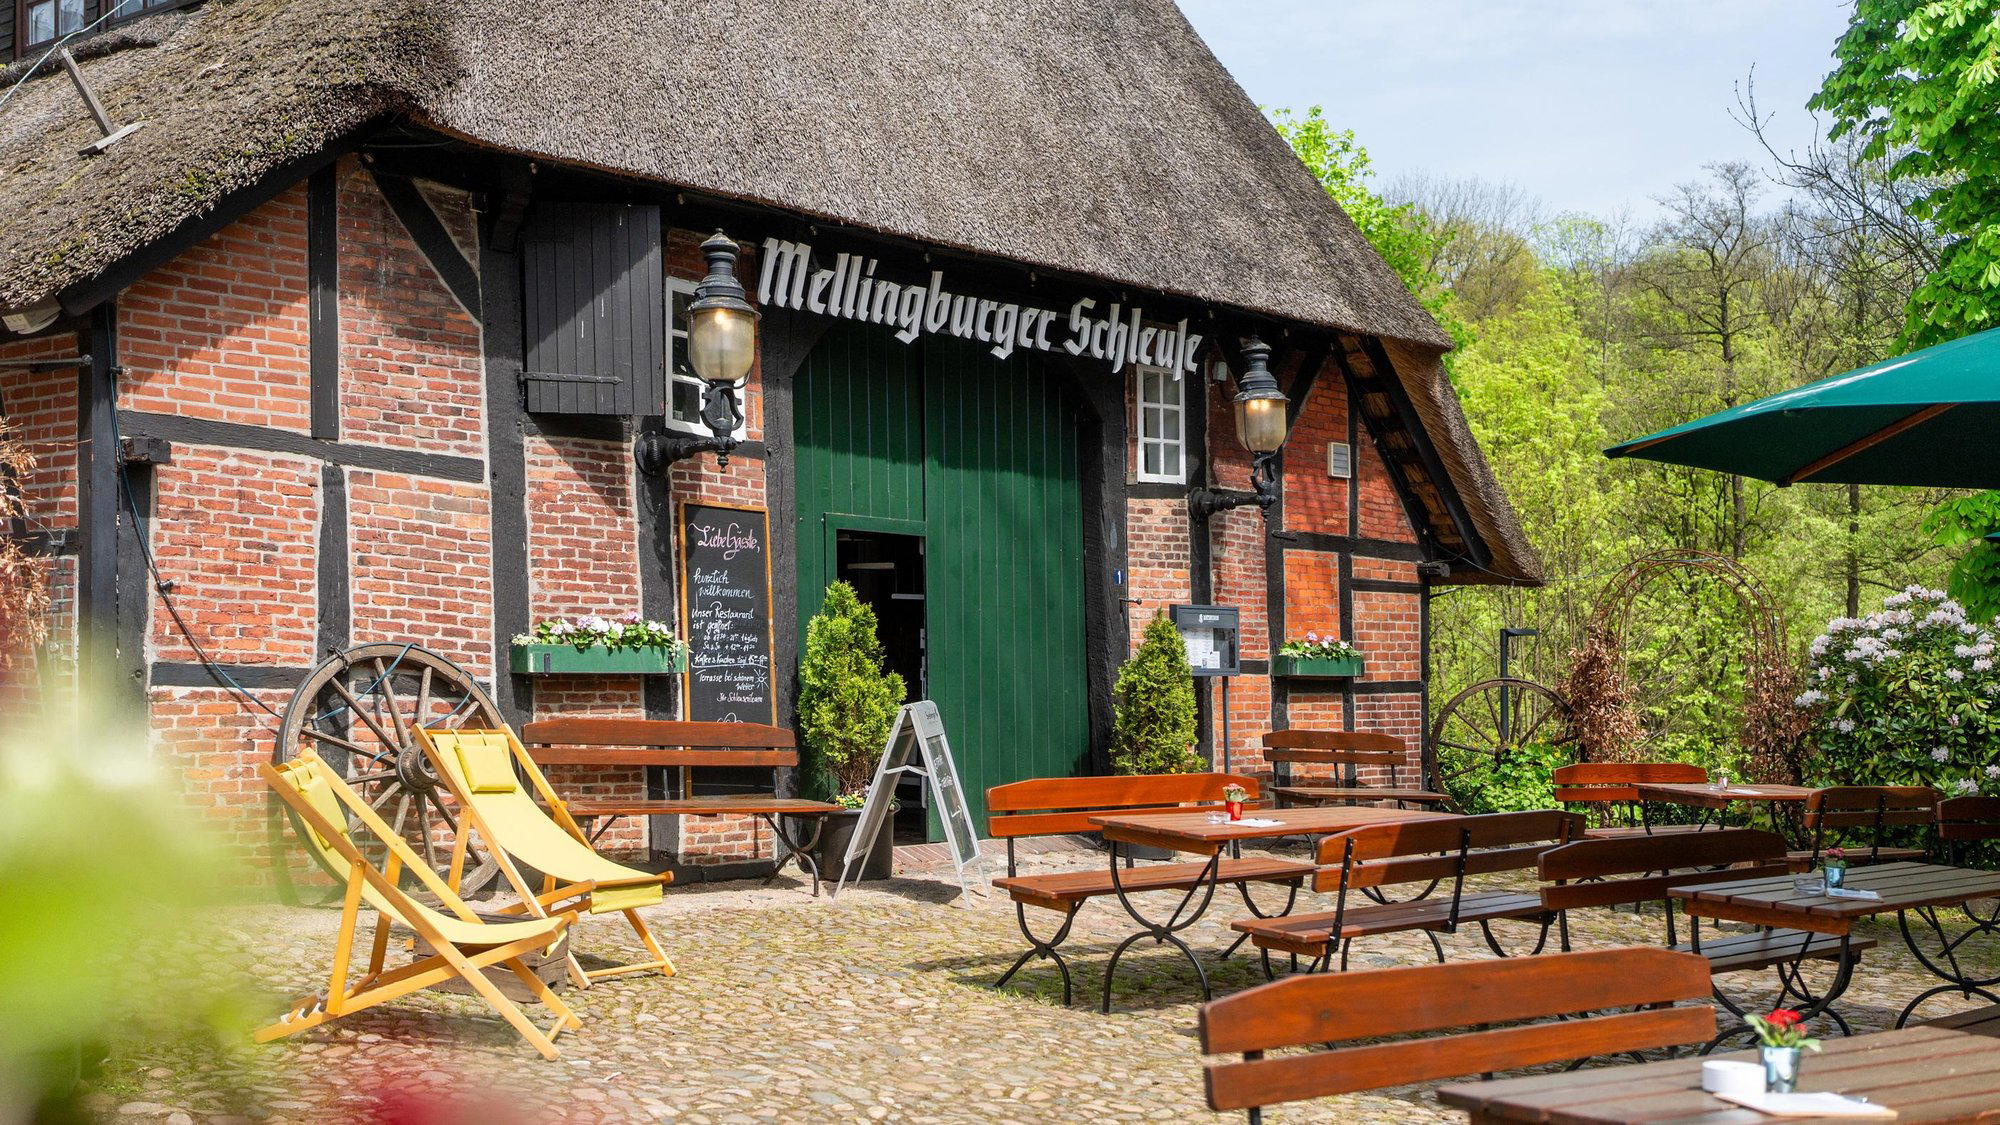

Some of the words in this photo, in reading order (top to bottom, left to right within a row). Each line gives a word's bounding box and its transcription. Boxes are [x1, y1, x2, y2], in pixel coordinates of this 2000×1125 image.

[757, 237, 1057, 360] Mellingburger
[690, 523, 727, 548] Liebe
[693, 567, 730, 584] herzlich
[1117, 570, 1121, 585] 1
[697, 584, 755, 599] willkommen
[691, 599, 712, 619] Unser
[710, 600, 754, 619] Restaurant
[692, 619, 704, 629] ist
[695, 668, 723, 683] Terrasse
[724, 670, 733, 682] bei
